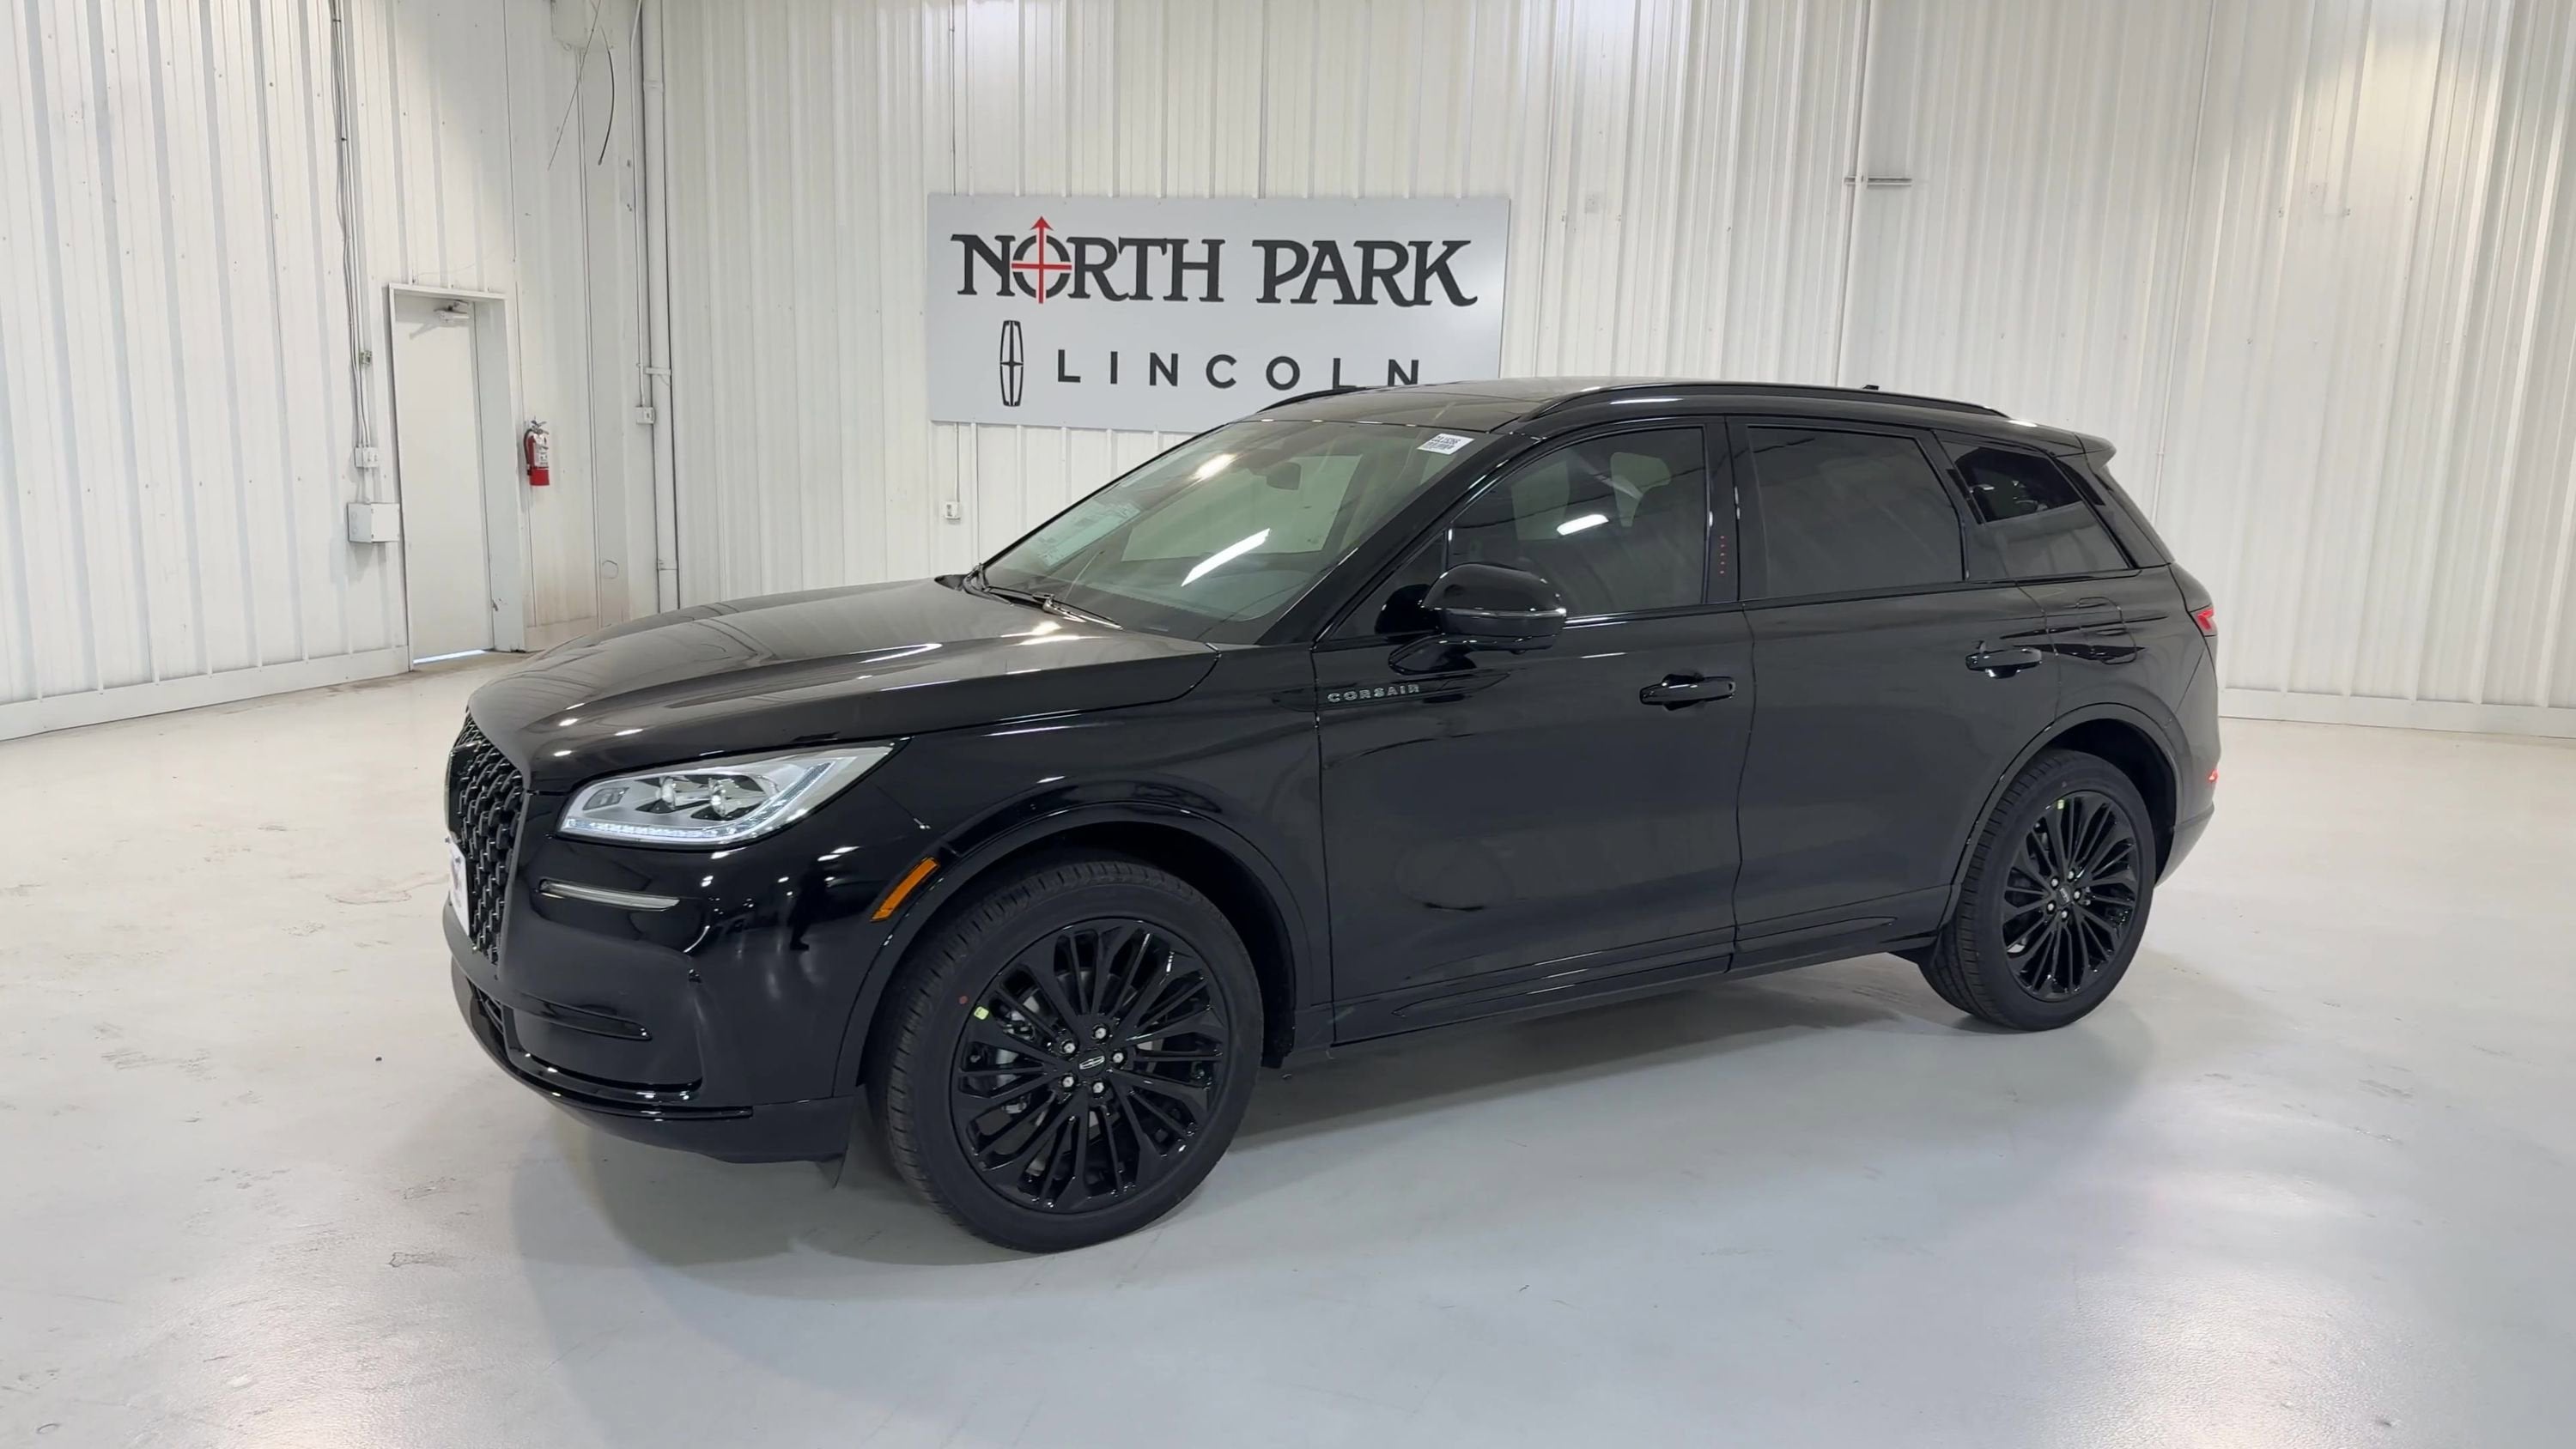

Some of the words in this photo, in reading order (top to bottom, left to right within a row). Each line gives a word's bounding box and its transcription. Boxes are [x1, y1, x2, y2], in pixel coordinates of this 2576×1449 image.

[951, 234, 1225, 302] NORTH
[1252, 239, 1478, 307] PARK
[1057, 349, 1419, 390] LINCOLN
[1327, 684, 1419, 702] CORSAIR
